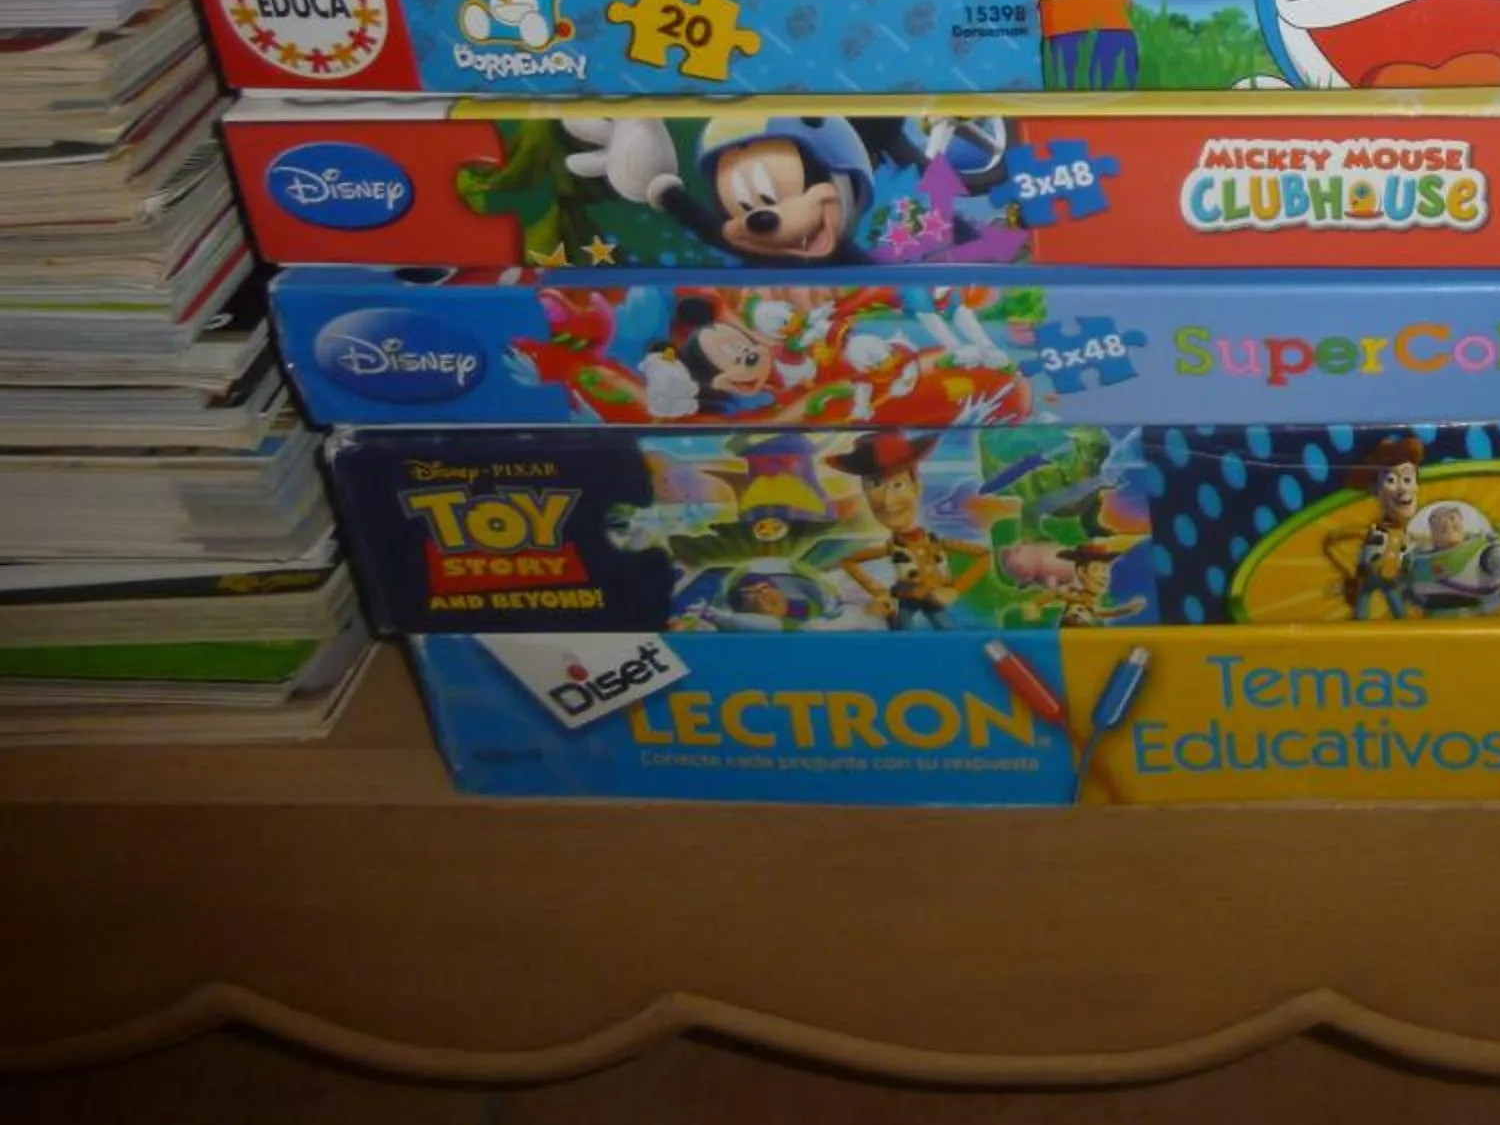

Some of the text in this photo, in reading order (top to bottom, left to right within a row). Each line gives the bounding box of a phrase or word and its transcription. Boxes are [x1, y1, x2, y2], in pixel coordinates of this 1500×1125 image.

[656, 4, 713, 49] 20
[1203, 146, 1465, 172] MICKEY MOUSE
[1015, 162, 1095, 201] 3x48
[1040, 334, 1127, 373] 3x48
[493, 463, 558, 476] PIXAR
[408, 490, 572, 549] TOY
[441, 557, 569, 577] STORY
[429, 588, 605, 610] AND BEYOND!
[1206, 653, 1427, 709] Temas
[627, 689, 1036, 749] LECTRON
